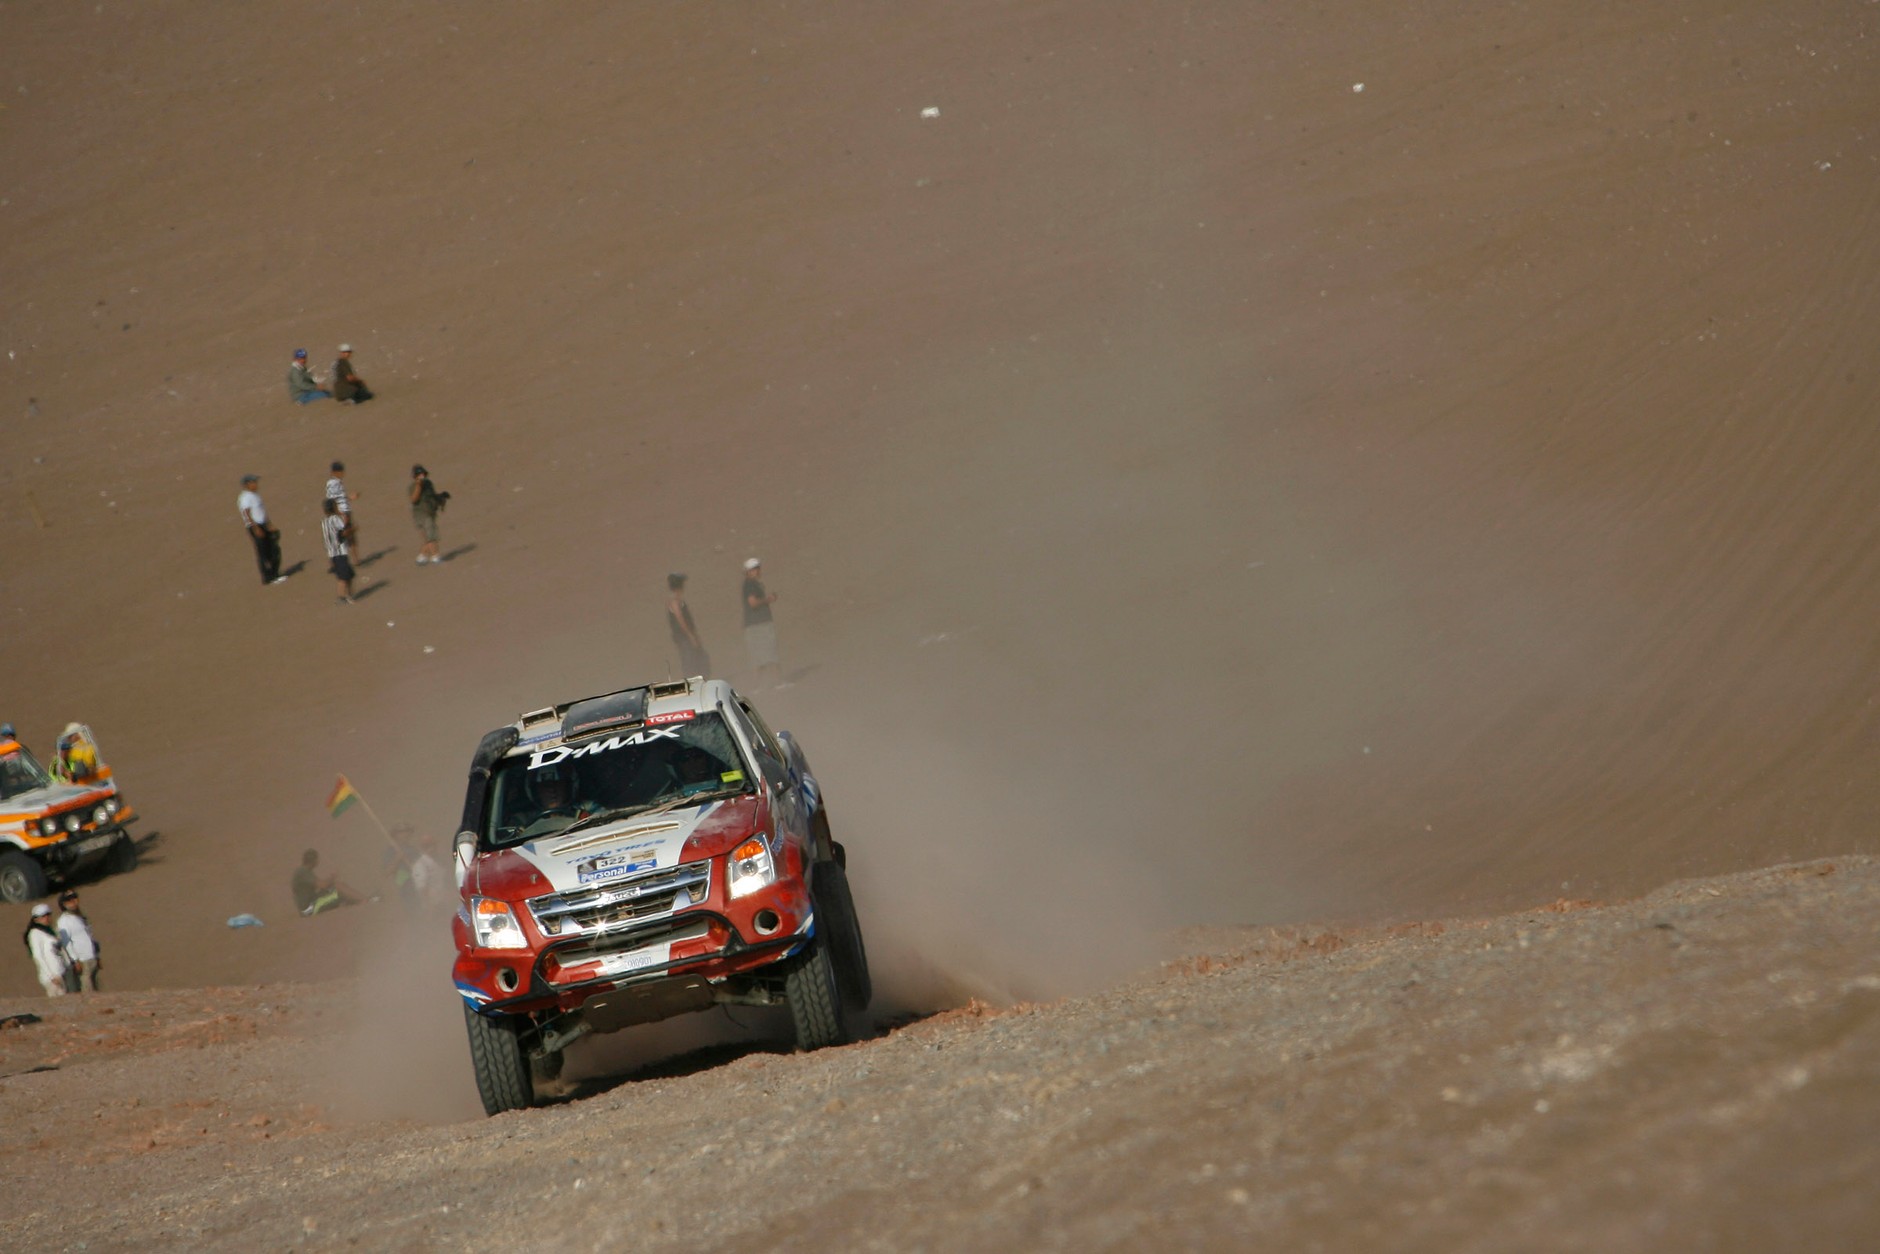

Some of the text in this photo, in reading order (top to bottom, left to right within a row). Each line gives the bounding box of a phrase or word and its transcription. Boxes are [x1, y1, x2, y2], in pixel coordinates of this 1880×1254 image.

[649, 713, 693, 724] TOTAL
[567, 849, 612, 865] TOYO
[616, 839, 666, 853] TIRES
[601, 856, 627, 867] 322
[581, 866, 627, 882] Personal
